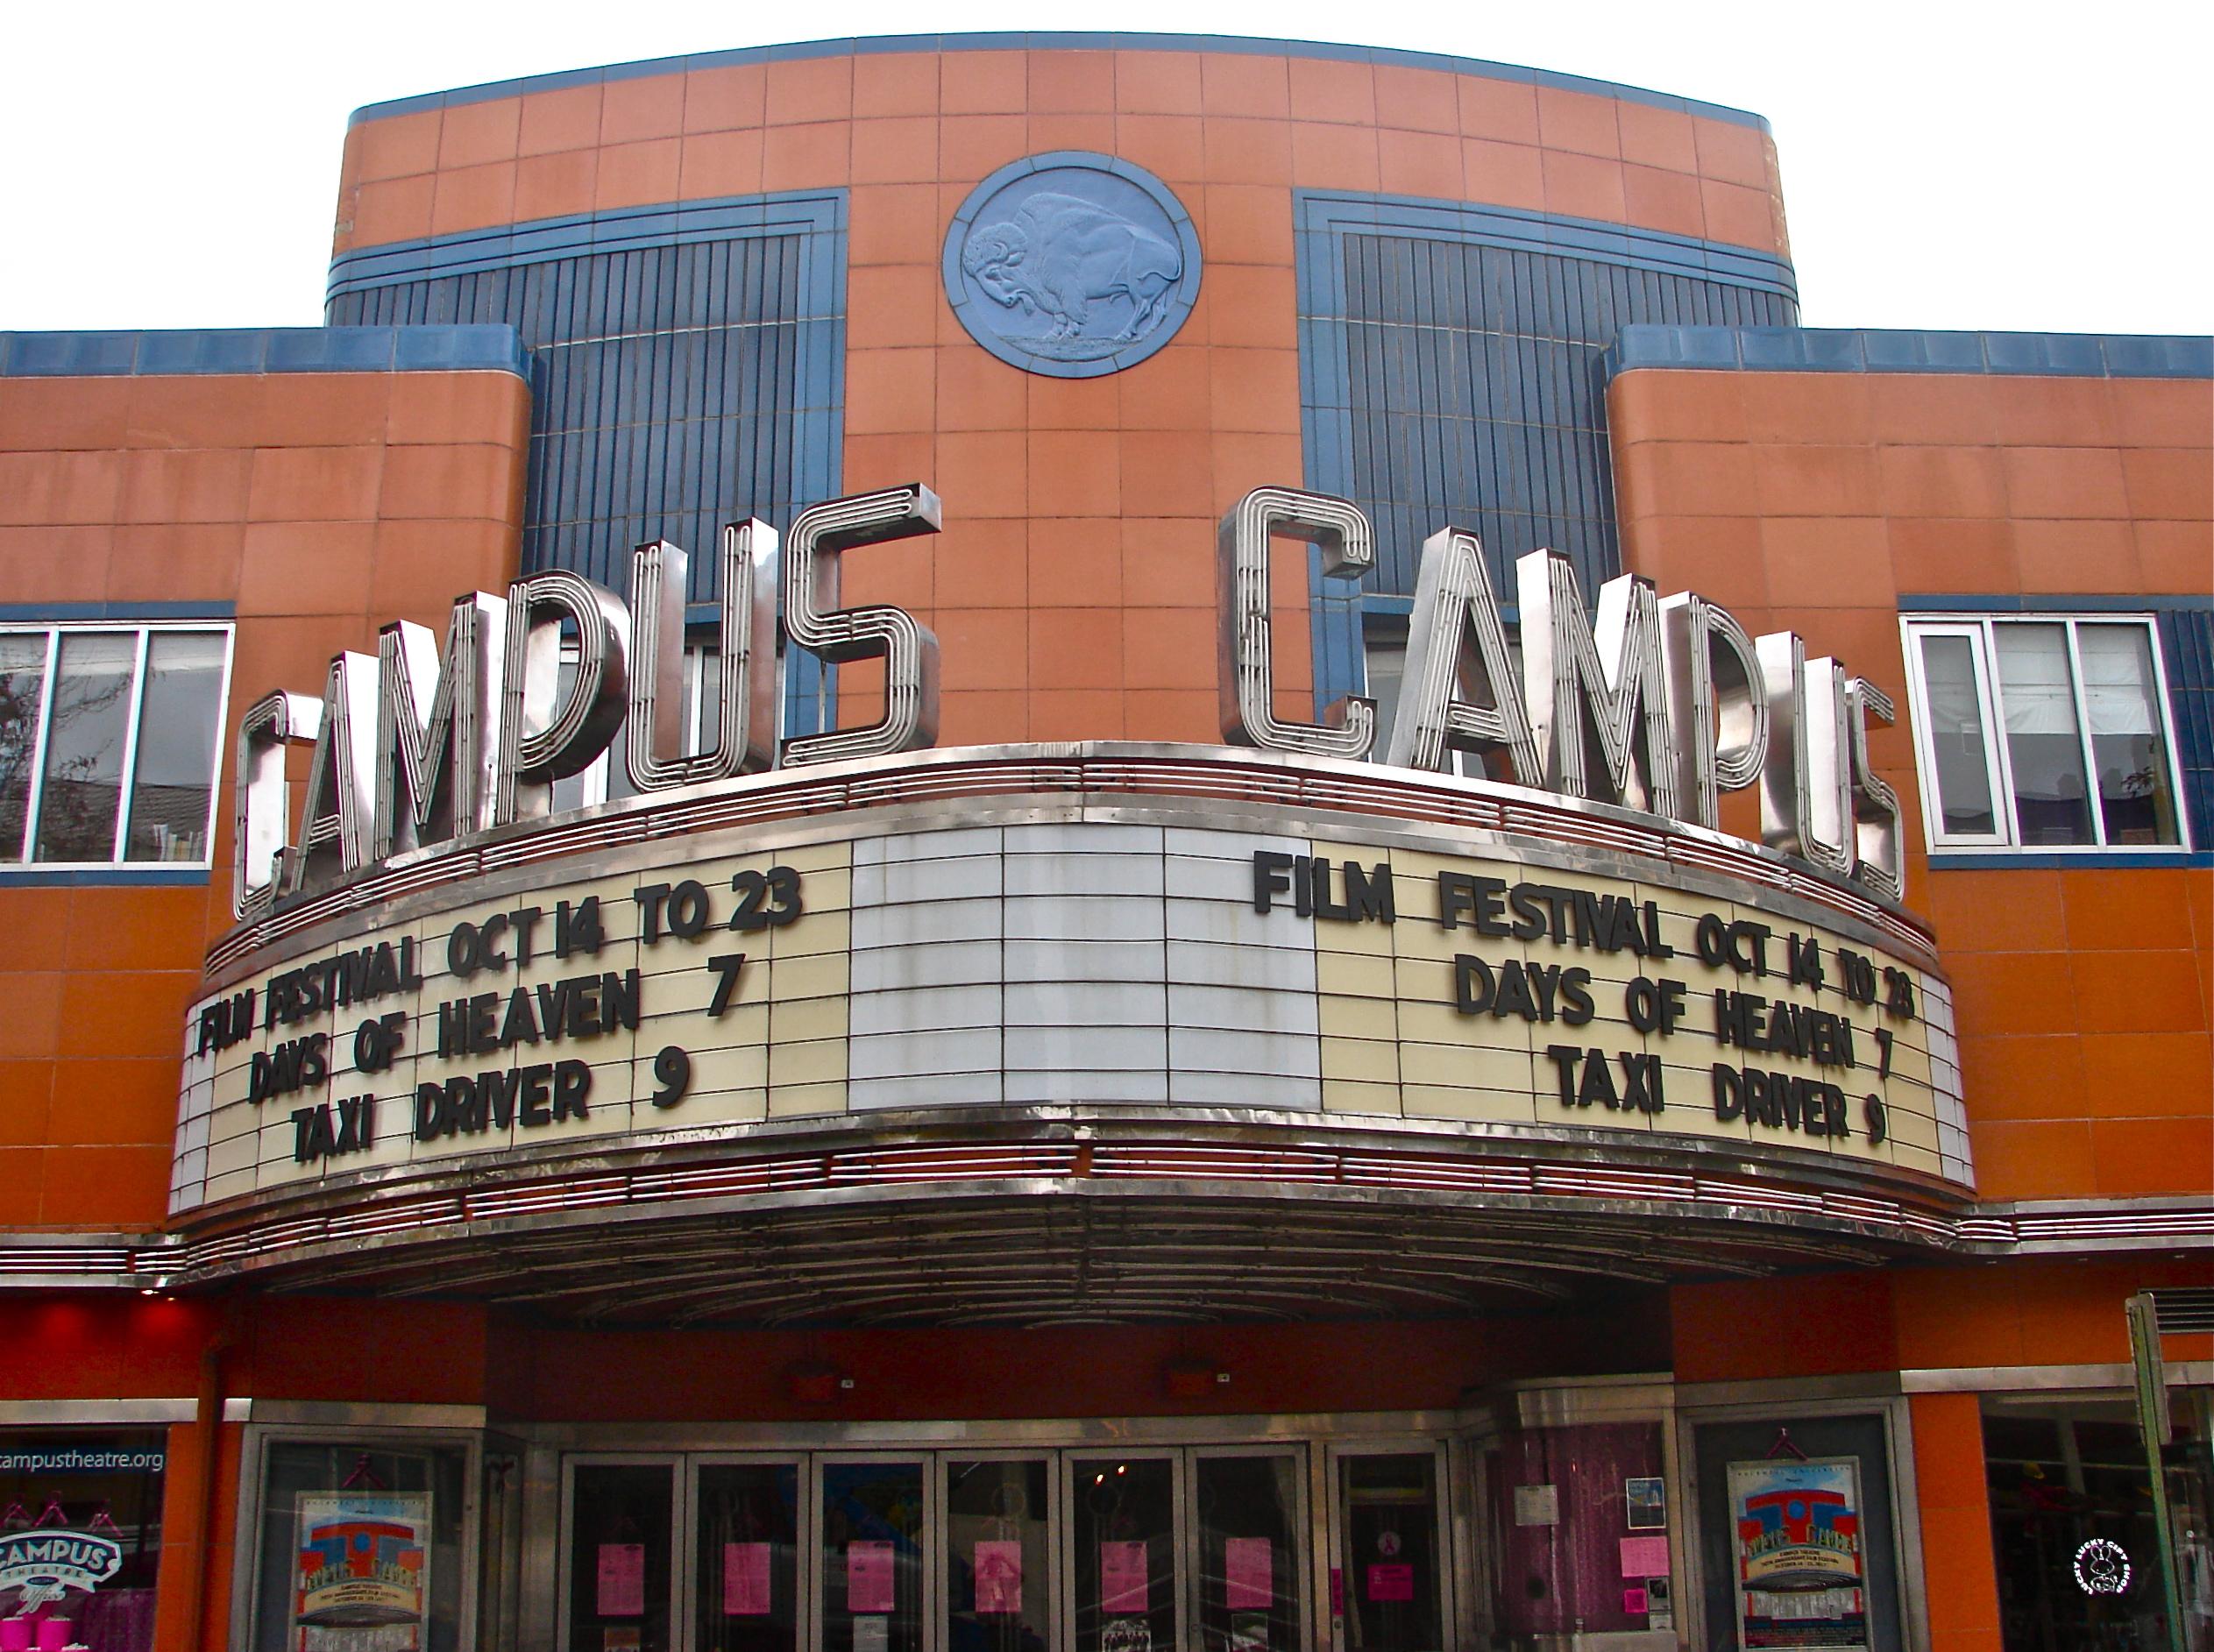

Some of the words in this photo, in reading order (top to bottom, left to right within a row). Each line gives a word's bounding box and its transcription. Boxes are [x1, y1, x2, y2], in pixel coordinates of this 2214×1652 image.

[234, 482, 941, 920] CAMPUS
[1218, 486, 1905, 902] CAMPUS
[198, 988, 255, 1057] FILM
[265, 936, 422, 1030] FESTIVAL
[447, 907, 541, 977] OCT
[556, 896, 605, 960] 14
[634, 879, 710, 946] TO
[729, 866, 803, 931] 23
[1253, 850, 1396, 924] FILM
[1438, 870, 1674, 959] FESTIVAL
[1698, 913, 1771, 977] OCT
[1789, 932, 1824, 991] 14
[1838, 947, 1877, 1006] TO
[1884, 966, 1914, 1019] 23
[249, 1032, 328, 1104] DAYS
[353, 1010, 407, 1074] OF
[438, 968, 640, 1059] HEAVEN
[706, 954, 746, 1017] 7
[1454, 954, 1595, 1025] DAYS
[1626, 976, 1686, 1035] OF
[1715, 989, 1856, 1069] HEAVEN
[1875, 1027, 1893, 1079] 7
[1548, 1044, 1664, 1113] TAXI
[1713, 1062, 1850, 1138] DRIVER
[1866, 1094, 1886, 1143] 9
[291, 1094, 374, 1162] TAXI
[415, 1059, 592, 1141] DRIVER
[652, 1046, 691, 1109] 9
